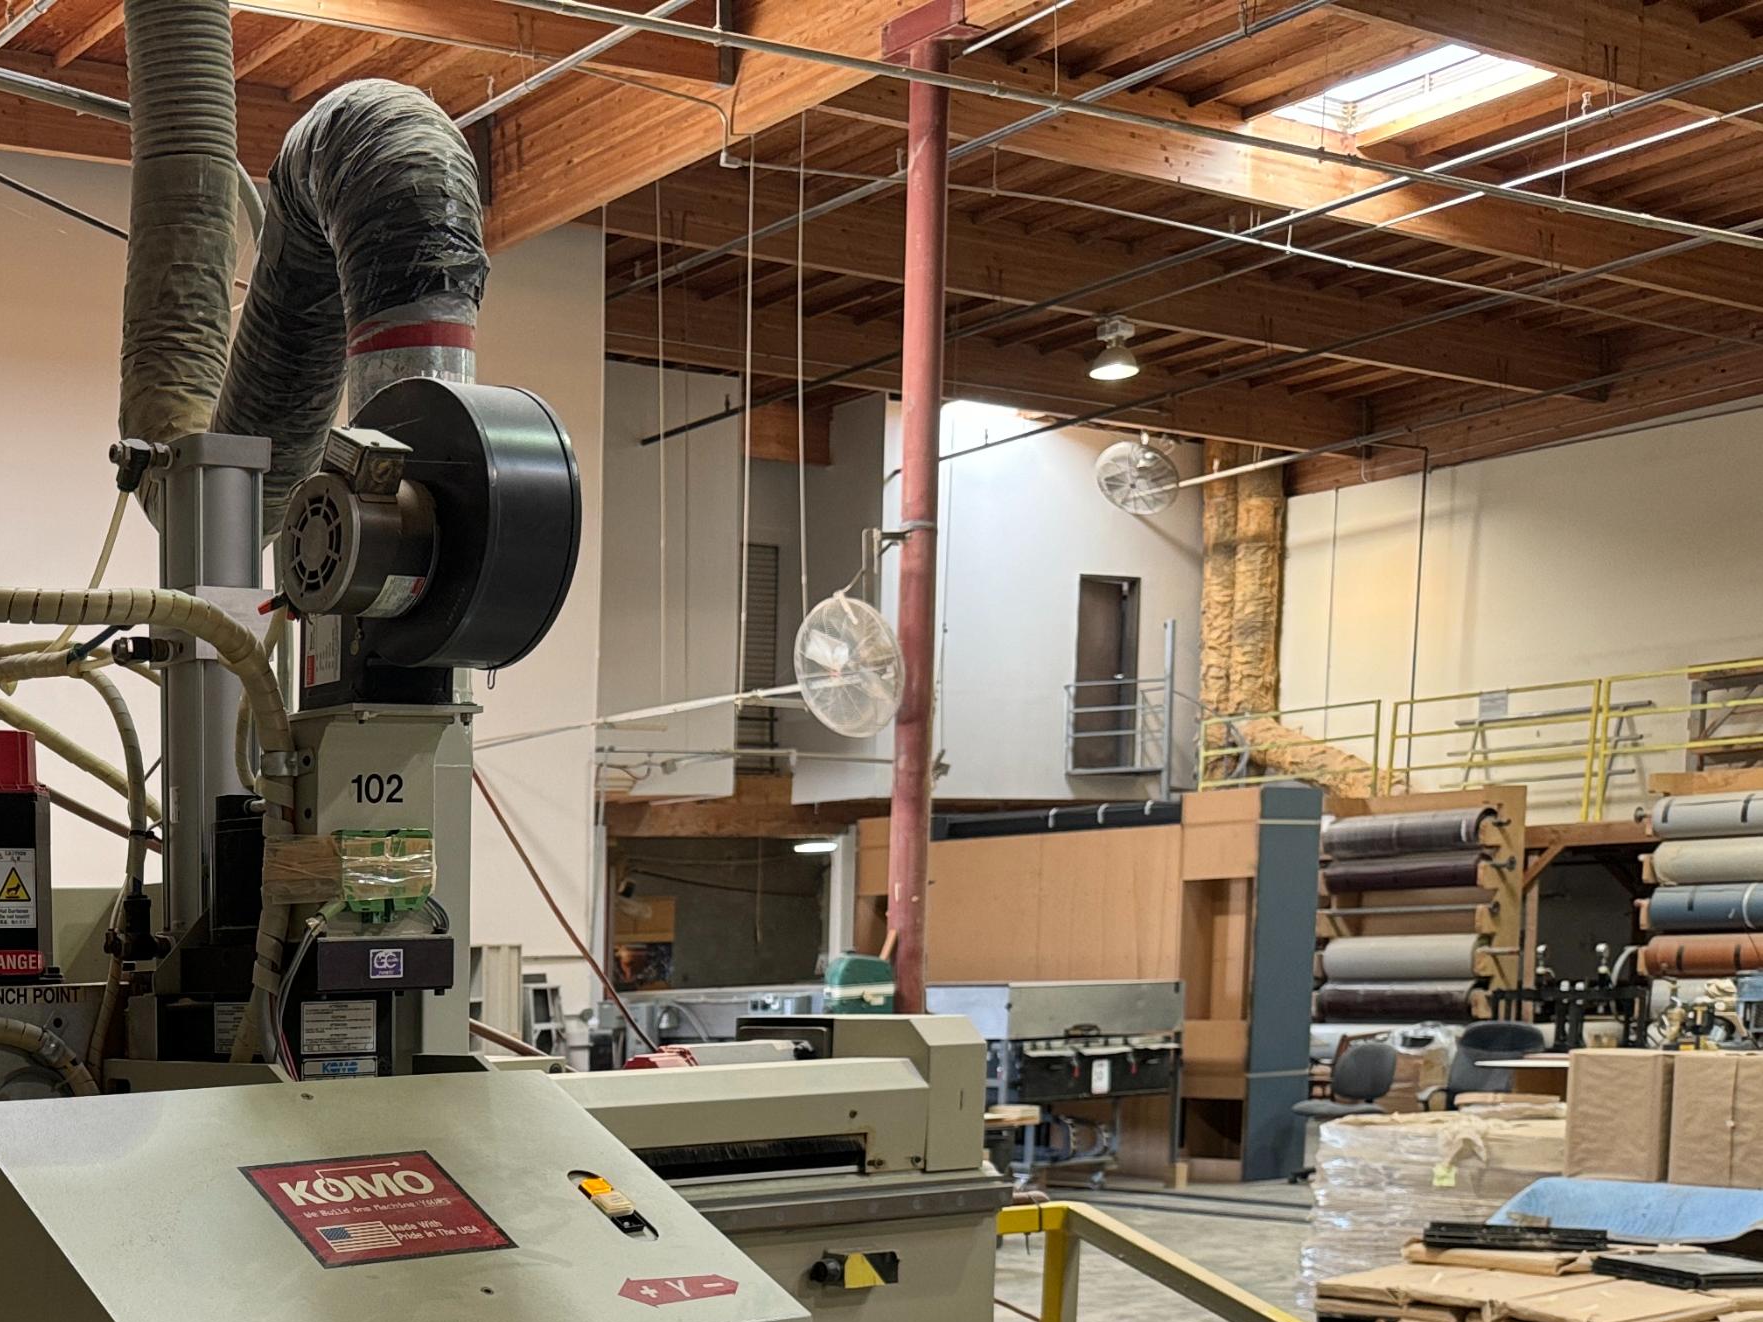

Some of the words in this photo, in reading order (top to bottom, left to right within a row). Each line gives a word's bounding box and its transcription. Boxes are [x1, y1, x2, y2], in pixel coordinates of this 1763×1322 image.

[351, 773, 403, 803] 102
[33, 986, 80, 1003] POINT
[278, 1170, 435, 1206] KOMO
[389, 1224, 417, 1233] Made
[418, 1220, 443, 1230] With
[396, 1231, 423, 1241] Pride
[437, 1228, 457, 1236] The
[459, 1225, 481, 1235] USA
[664, 1280, 691, 1297] Y
